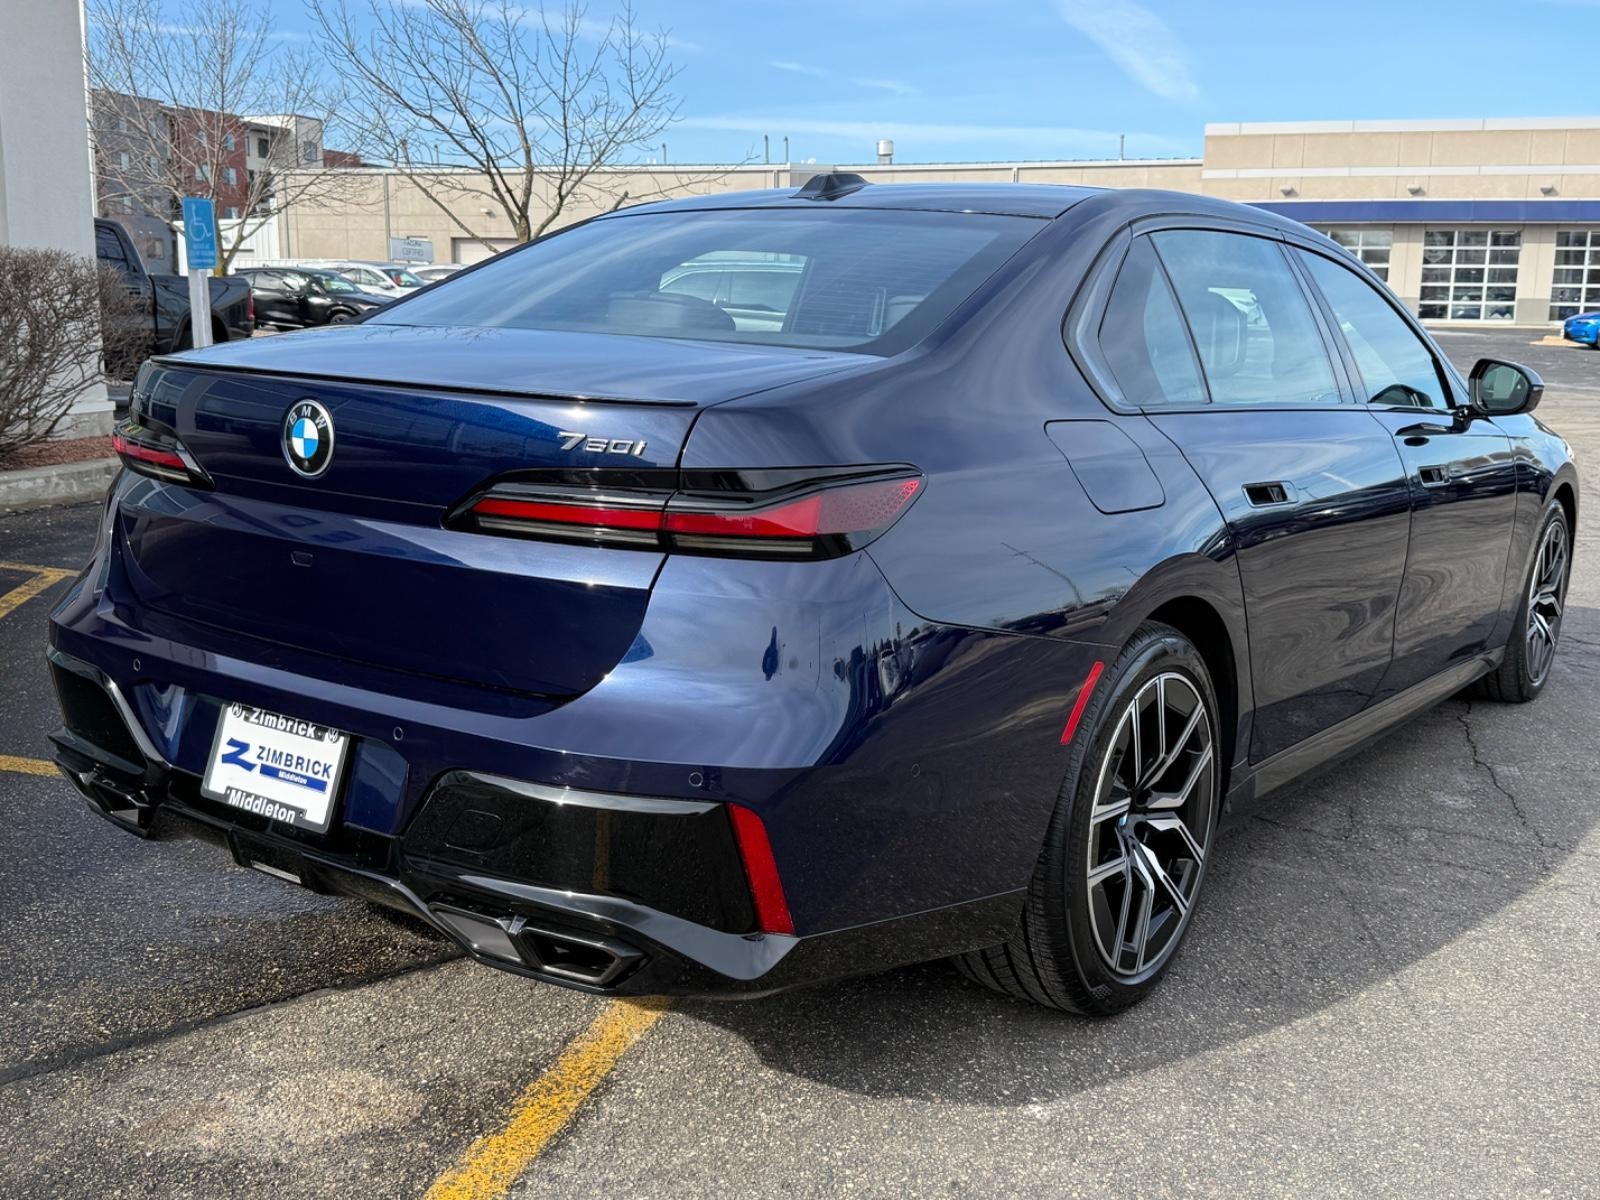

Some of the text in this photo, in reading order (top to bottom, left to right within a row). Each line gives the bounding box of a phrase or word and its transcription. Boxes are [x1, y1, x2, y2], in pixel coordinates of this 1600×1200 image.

[289, 405, 327, 429] BMW
[251, 707, 317, 738] Zimbrick
[256, 745, 333, 779] ZIMBRICK
[228, 788, 297, 824] Middleton
